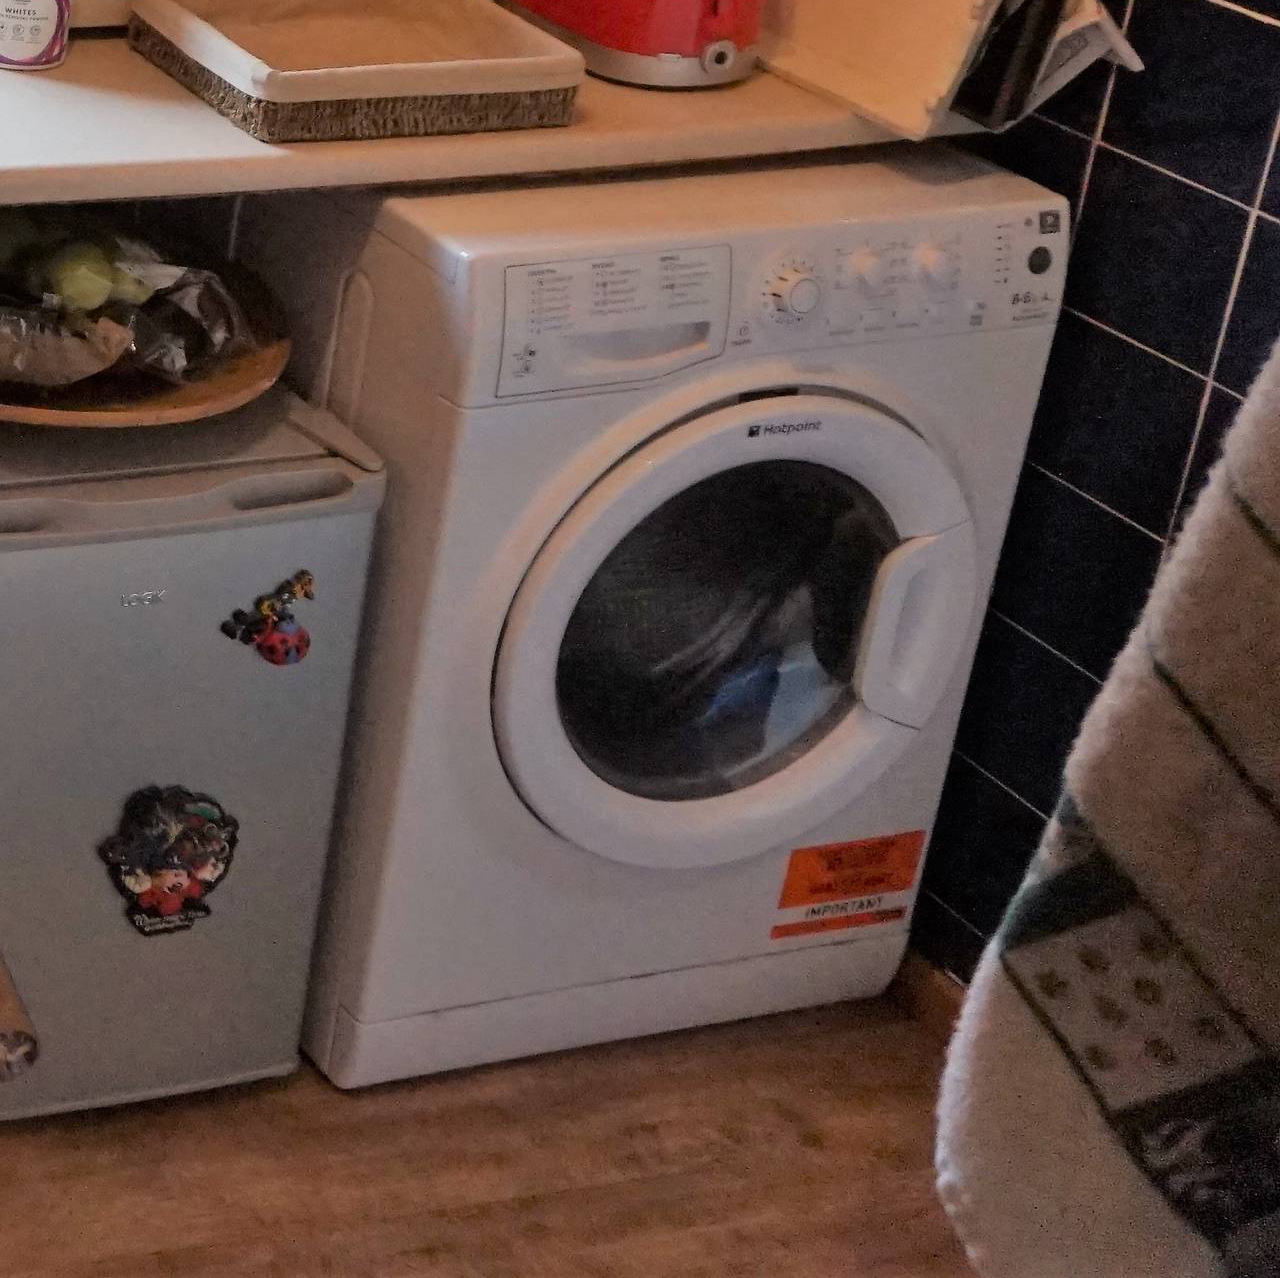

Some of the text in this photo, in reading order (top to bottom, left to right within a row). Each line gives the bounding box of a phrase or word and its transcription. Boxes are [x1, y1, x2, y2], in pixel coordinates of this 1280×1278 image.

[4, 6, 38, 17] WHITES
[763, 420, 822, 437] Hotpoint
[805, 895, 883, 918] IMPORTANT
